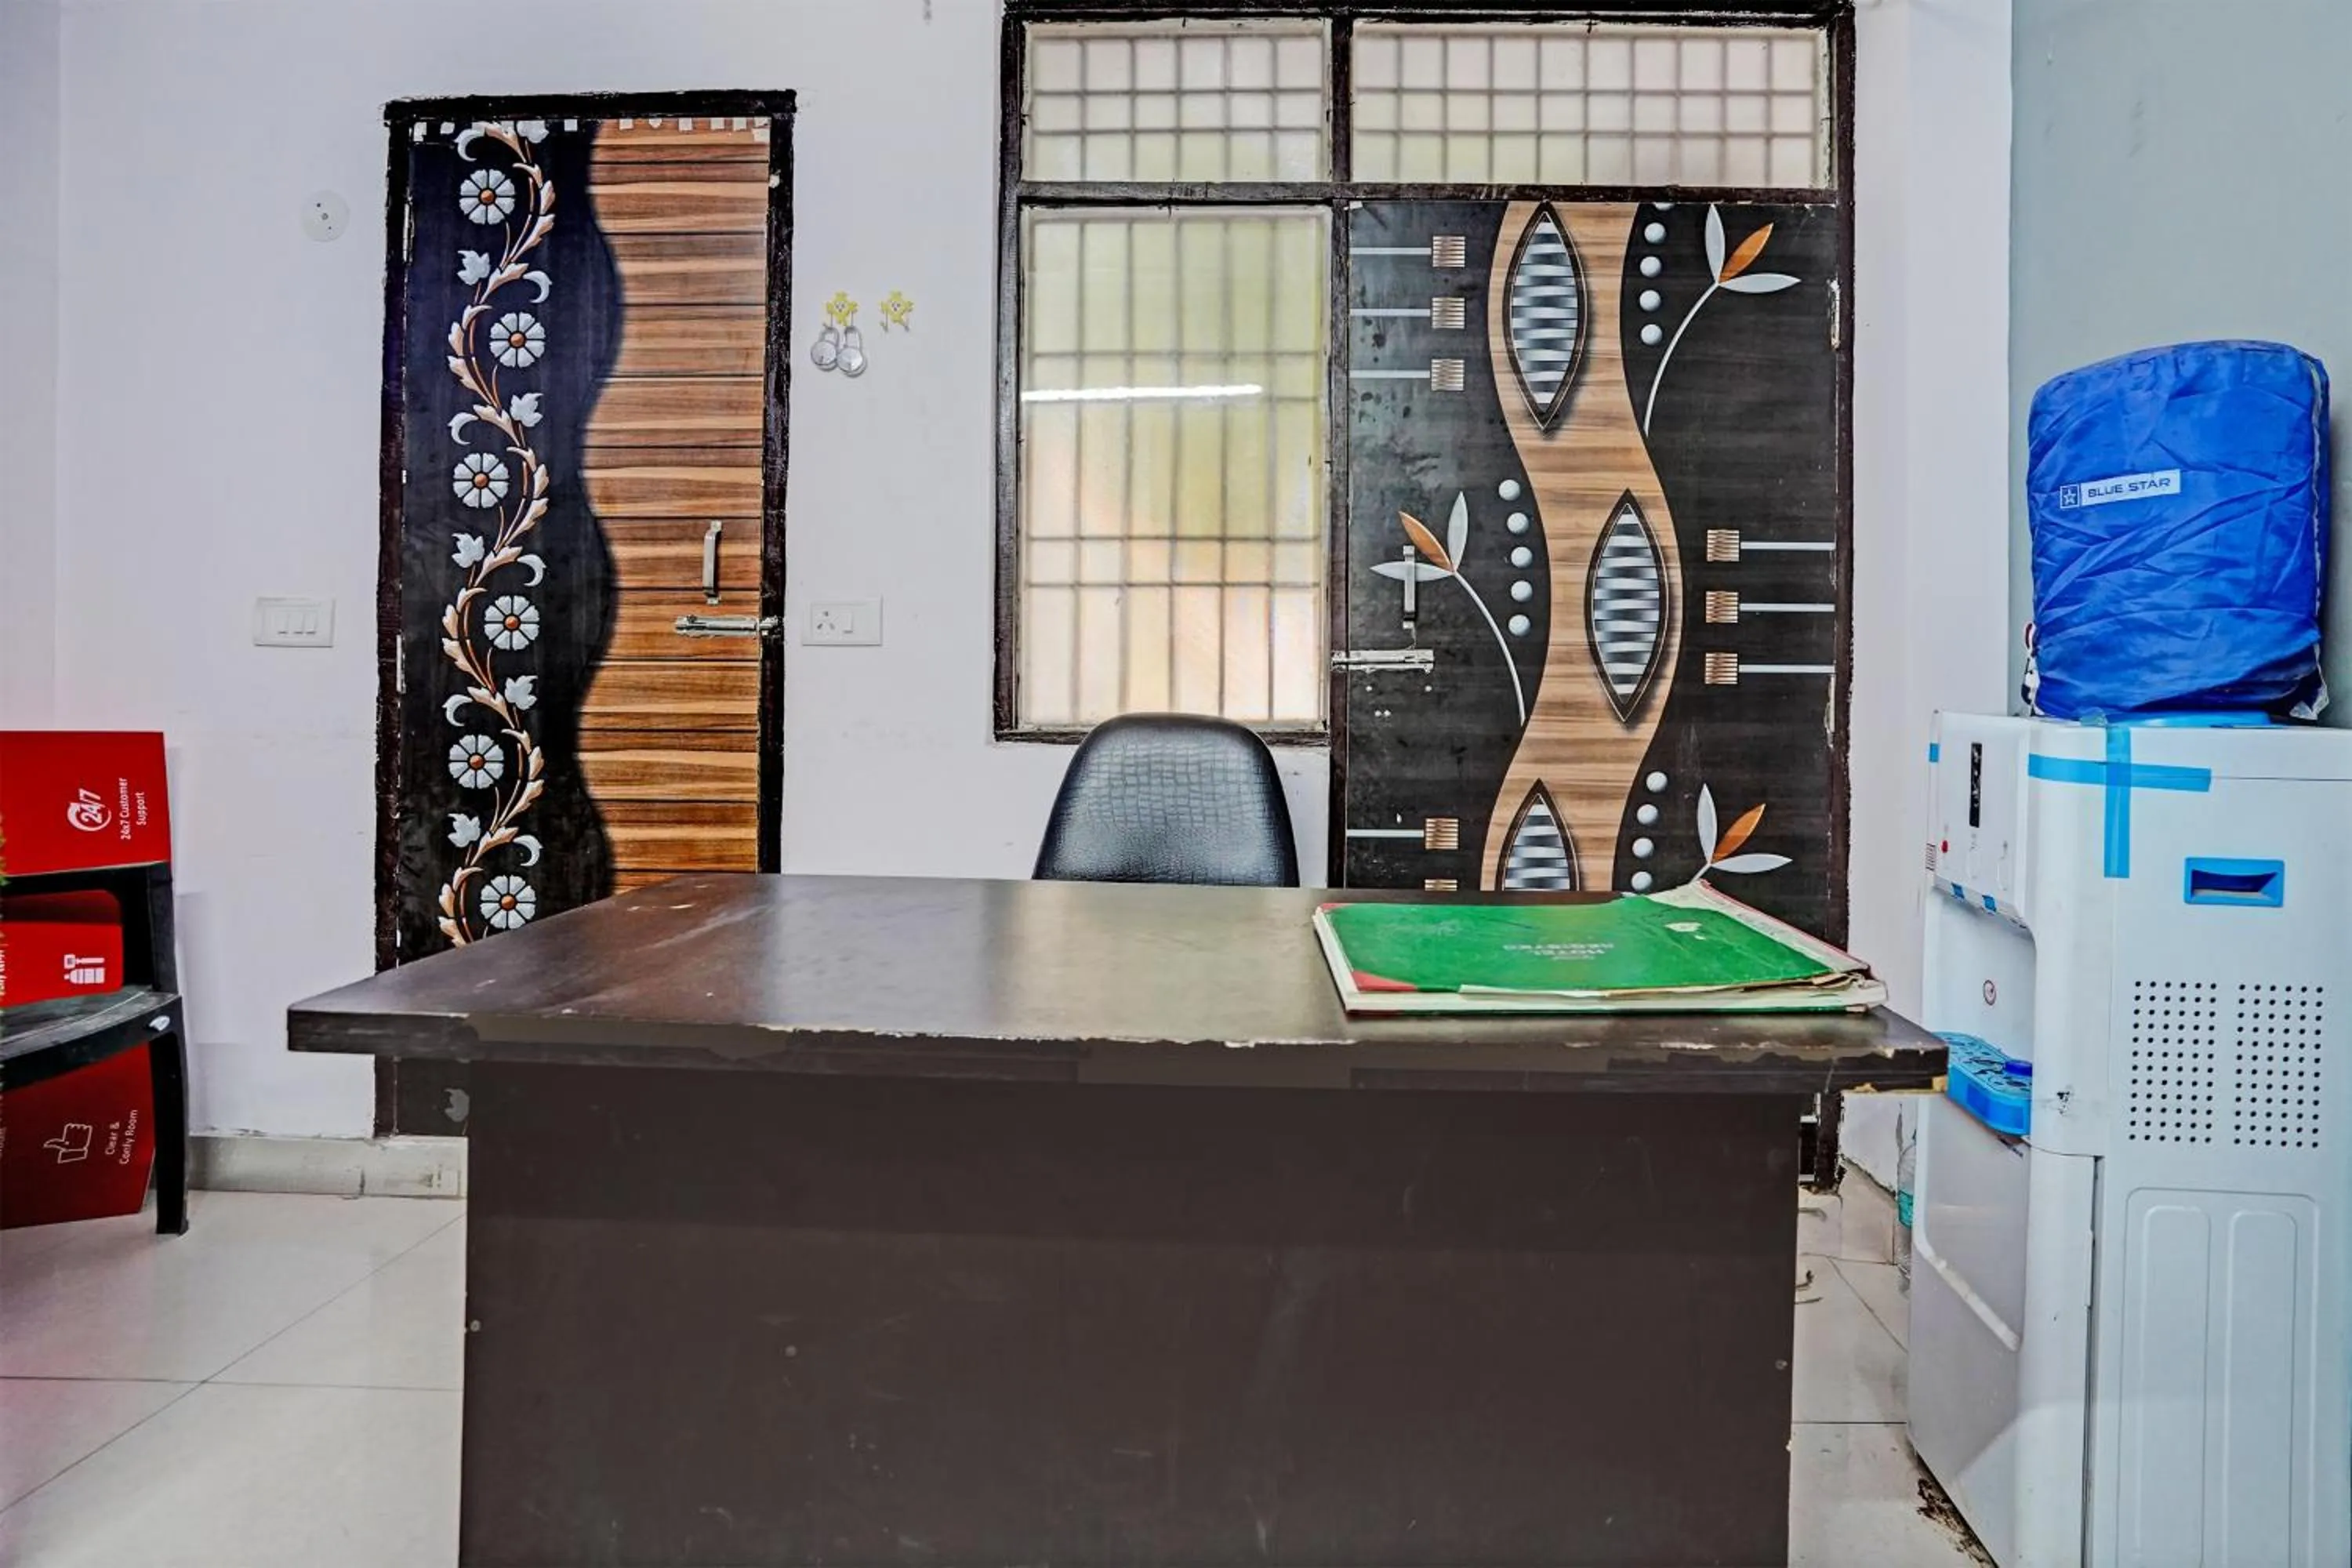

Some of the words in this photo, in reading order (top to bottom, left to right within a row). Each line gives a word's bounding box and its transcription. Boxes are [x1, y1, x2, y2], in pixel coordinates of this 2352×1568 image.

[2088, 483, 2123, 498] BLUE
[2129, 477, 2171, 492] STAR
[118, 777, 129, 818] Customer
[135, 792, 147, 826] Support
[125, 1109, 138, 1136] Room
